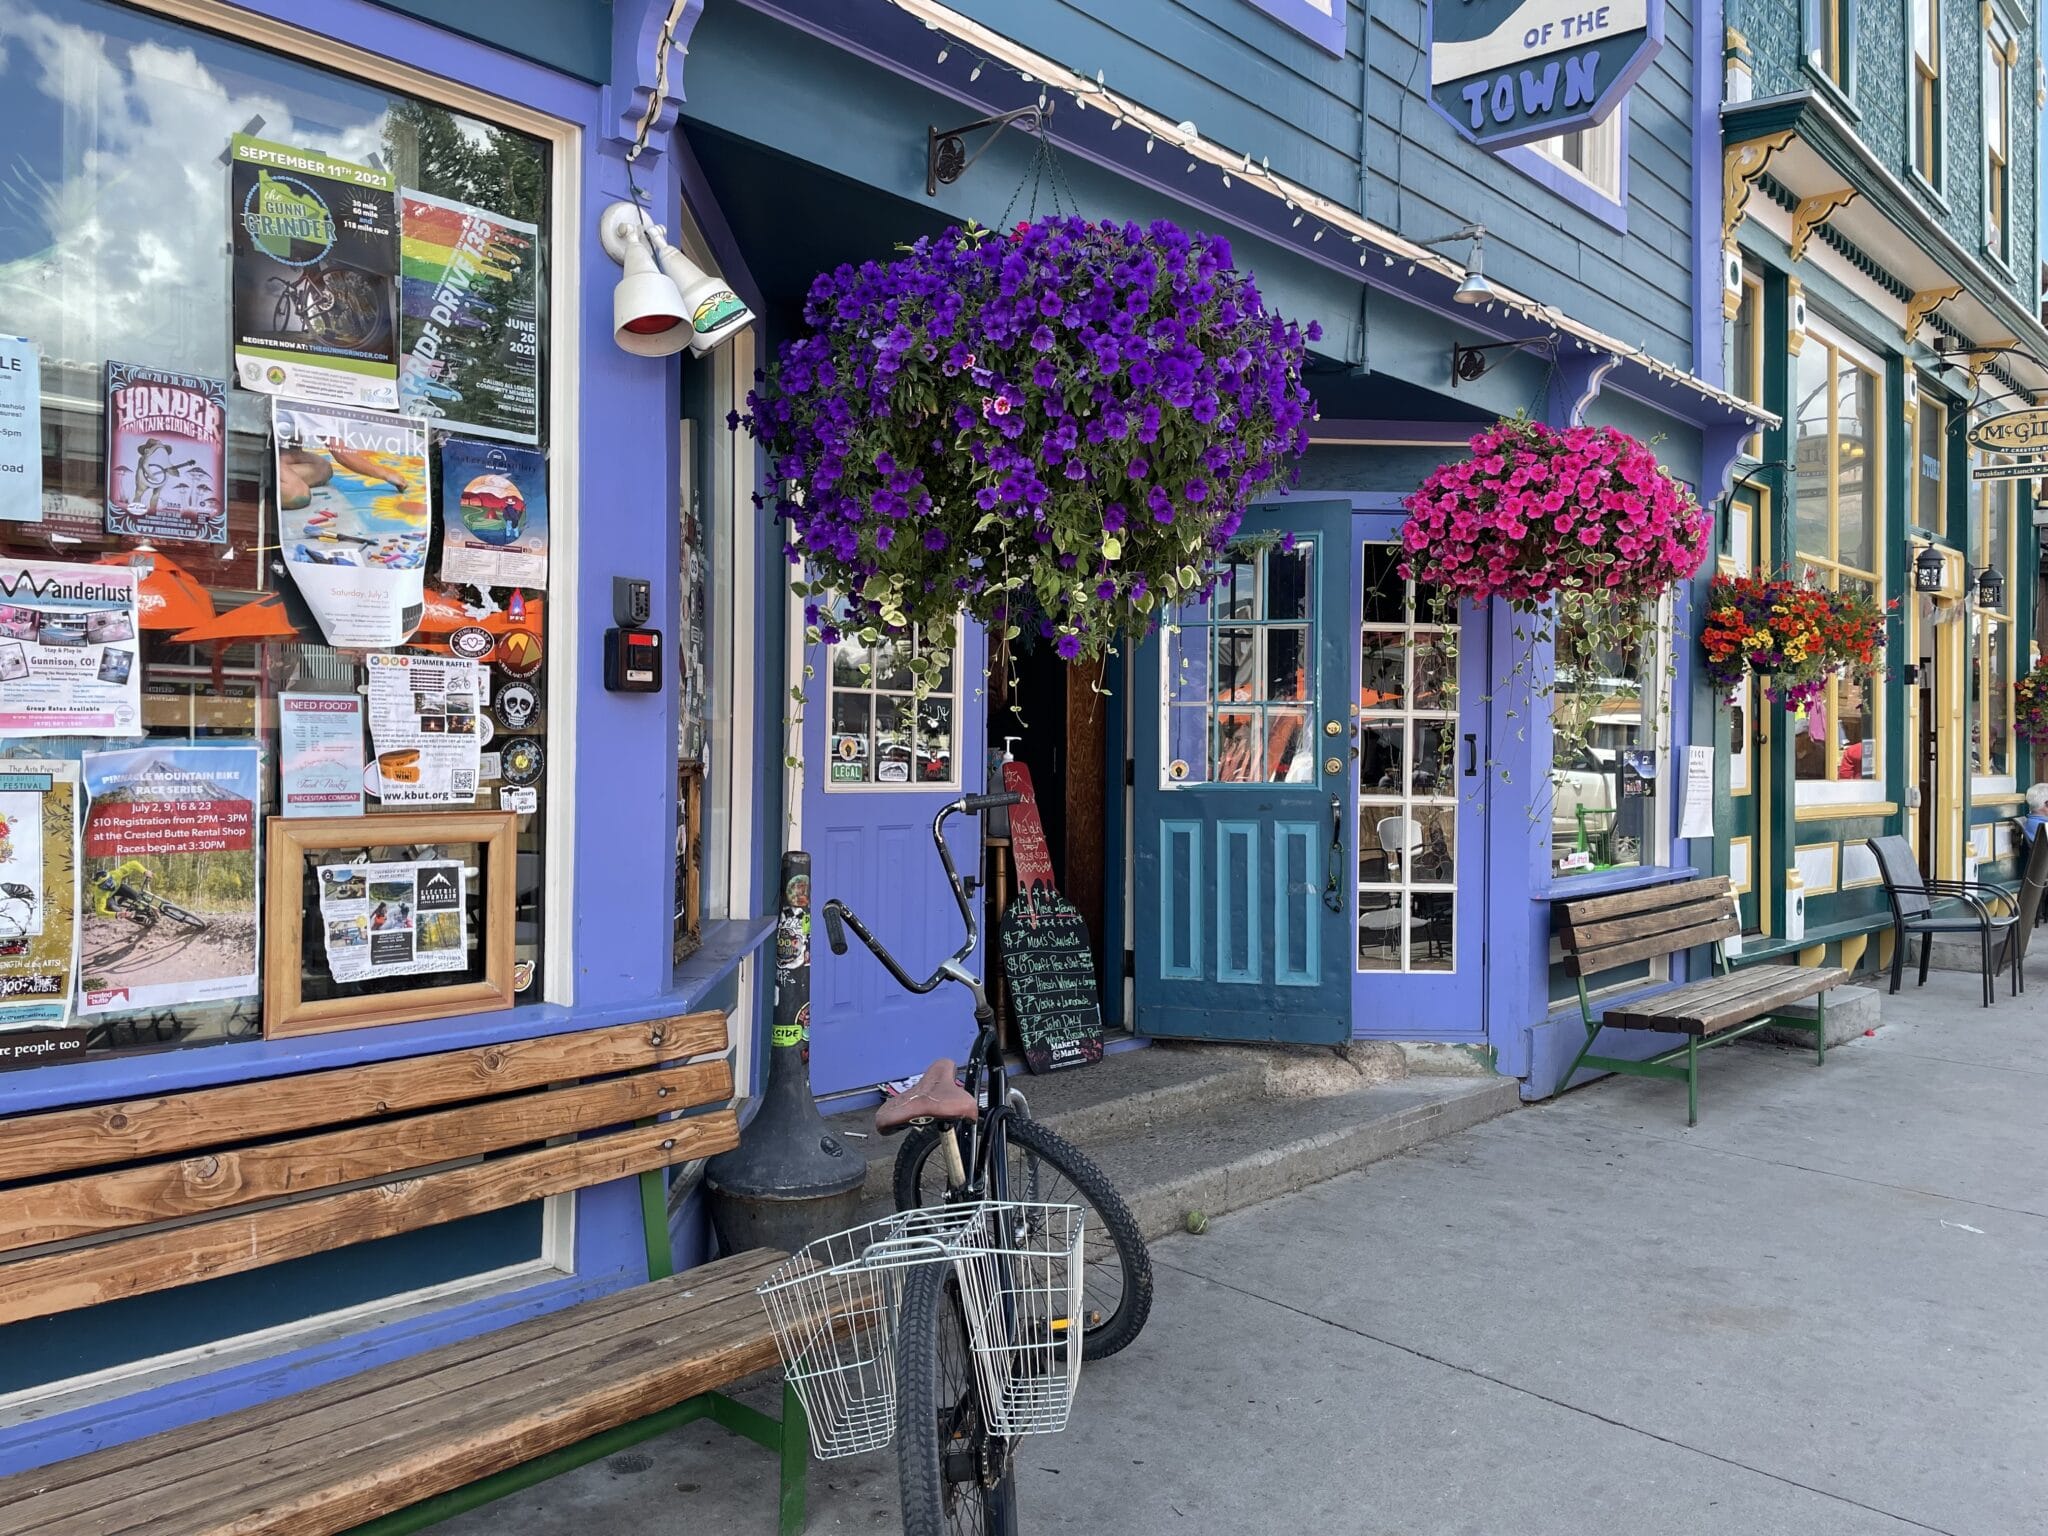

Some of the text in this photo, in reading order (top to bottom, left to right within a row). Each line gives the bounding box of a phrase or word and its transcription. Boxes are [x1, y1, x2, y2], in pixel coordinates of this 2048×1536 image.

[1523, 6, 1610, 49] OF THE
[1462, 50, 1600, 129] TOWN
[239, 145, 325, 173] SEPTEMBER
[354, 171, 387, 187] 2021
[264, 188, 282, 202] the
[265, 201, 306, 217] GUNNI
[242, 212, 338, 242] GRINDER
[505, 318, 535, 332] JUNE
[242, 336, 278, 347] REGISTER
[279, 341, 295, 349] NOW
[520, 332, 535, 344] 20
[509, 342, 535, 356] 2021
[116, 386, 222, 439] YONDER
[0, 463, 24, 473] oad
[1974, 467, 2035, 478] Breakfast Lunch
[31, 656, 78, 667] Gunnison,
[412, 659, 444, 667] SUMMER
[290, 701, 352, 710] NEED FOOD?
[8, 765, 23, 773] The
[24, 765, 38, 773] Arts
[834, 769, 860, 777] LEGAL
[155, 772, 214, 781] MOUNTAIN
[216, 771, 240, 780] BIKE
[3, 782, 42, 790] FESTIVAL
[136, 786, 203, 795] RACE SERIES
[131, 802, 211, 814] July 2, 9, 16 & 23
[93, 817, 111, 827] $10
[114, 817, 171, 828] Registration
[172, 815, 195, 825] from
[197, 815, 218, 824] 2PM
[227, 813, 248, 823] 3PM
[94, 826, 246, 841] at the Crested Butte Rental Shop
[116, 845, 145, 853] Races
[147, 843, 175, 854] begin
[189, 841, 226, 850] 3:30PM
[15, 1040, 55, 1057] people
[60, 1040, 80, 1049] too
[1051, 1039, 1080, 1051] Maker's
